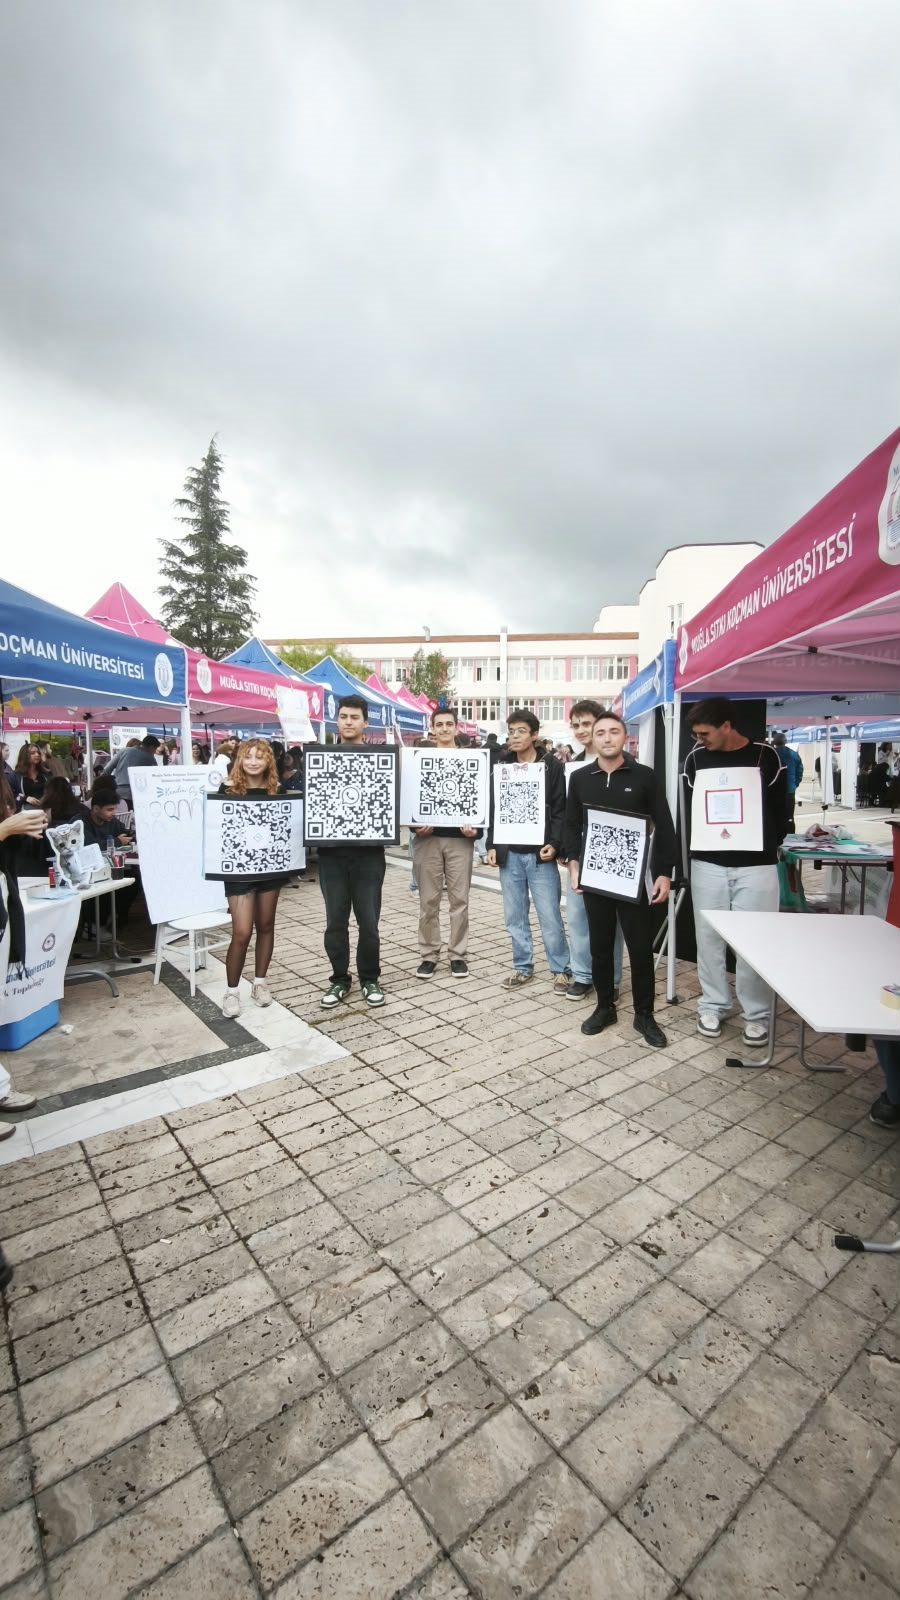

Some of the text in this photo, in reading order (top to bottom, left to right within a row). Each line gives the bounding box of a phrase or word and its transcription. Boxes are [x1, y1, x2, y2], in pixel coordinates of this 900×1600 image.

[691, 512, 857, 655] MUĞLA SITKI KOÇMAN ÜNİVERSİTESİ
[61, 641, 145, 680] ÜNİVERSİTESİ
[219, 675, 244, 692] MUĞLA
[244, 681, 260, 694] SITKI
